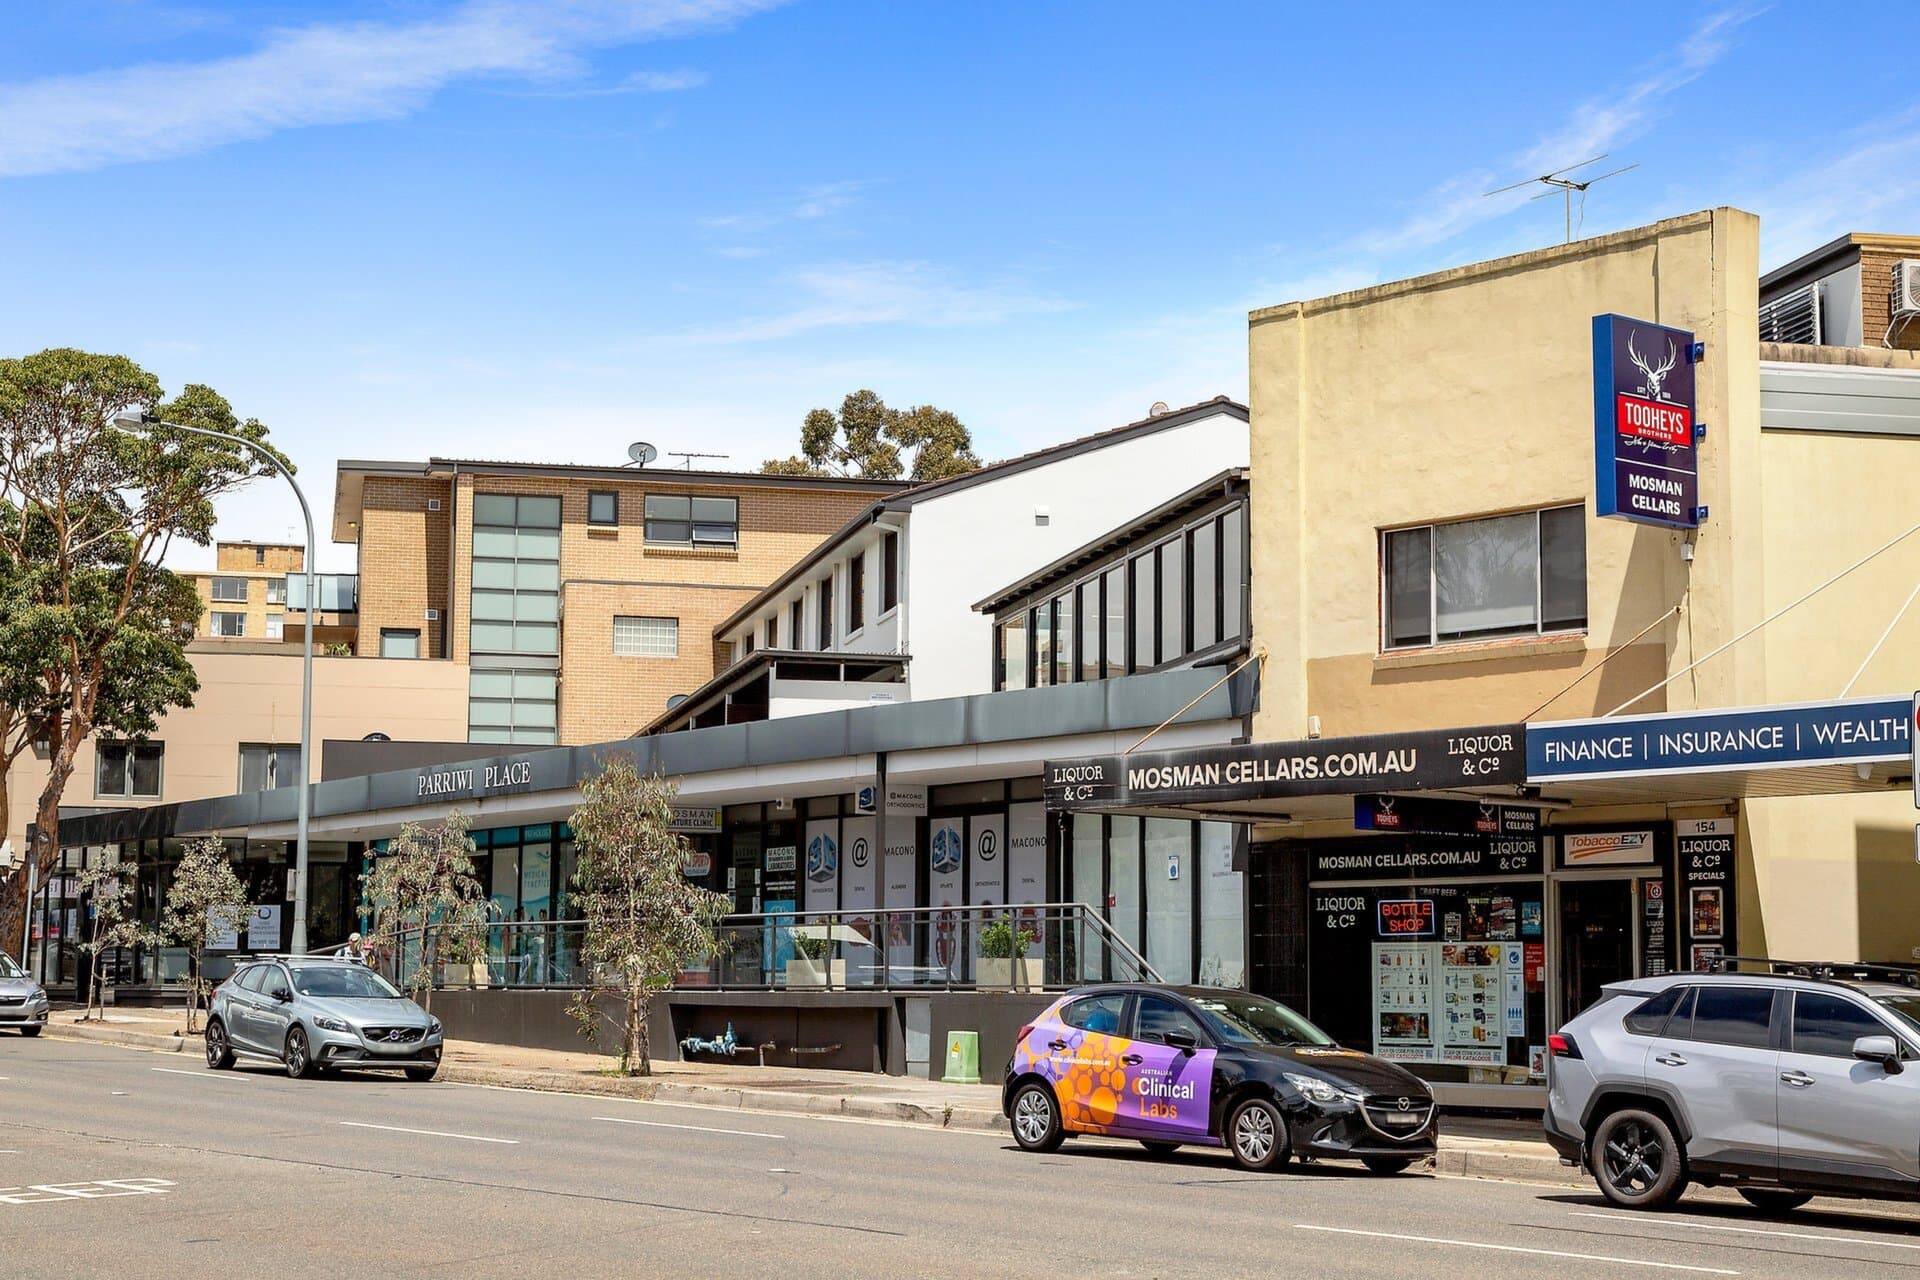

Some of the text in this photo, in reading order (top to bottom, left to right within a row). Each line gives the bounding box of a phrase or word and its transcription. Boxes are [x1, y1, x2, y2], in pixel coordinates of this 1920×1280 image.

[1625, 402, 1684, 435] TOOHEYS
[1638, 427, 1672, 440] BROTHERS
[1629, 473, 1683, 497] MOSMAN
[1632, 494, 1681, 515] CELLARS
[1448, 734, 1514, 755] LIQUOR
[1545, 717, 1909, 763] FINANCE INSURANCE WEALTH
[1054, 765, 1104, 783] LIQUOR
[1128, 749, 1417, 790] MOSMAN CELLARS.COM.AU
[1462, 760, 1475, 776] &
[417, 761, 531, 796] PARRIWI PLACE
[1064, 788, 1074, 801] &
[886, 801, 926, 809] ORTHODONTICS
[672, 809, 714, 818] OSMAN
[1376, 814, 1398, 824] TOOHEYS
[1504, 811, 1536, 821] MOSMAN
[1506, 820, 1535, 831] CELLARS
[1695, 821, 1716, 833] 154
[978, 829, 997, 861] @
[1011, 836, 1047, 849] MACONO
[1570, 834, 1648, 847] TobaccoEZY
[1681, 840, 1732, 854] LIQUOR
[852, 837, 868, 868] @
[884, 844, 915, 857] MACONO
[1490, 841, 1537, 855] LIQUOR
[1319, 851, 1481, 869] MOSMAN CELLARS.COM.AU
[1500, 857, 1509, 869] &
[1692, 857, 1702, 868] &
[1688, 871, 1726, 881] SPECIALS
[1441, 888, 1457, 896] BEER
[1316, 897, 1365, 911] LIQUOR
[1382, 904, 1431, 916] BOTTLE
[1327, 915, 1337, 928] &
[1389, 919, 1425, 932] SHOP
[1141, 1068, 1173, 1076] AUSTRALIAN
[1138, 1077, 1194, 1100] Clinical
[1139, 1098, 1178, 1119] Labs
